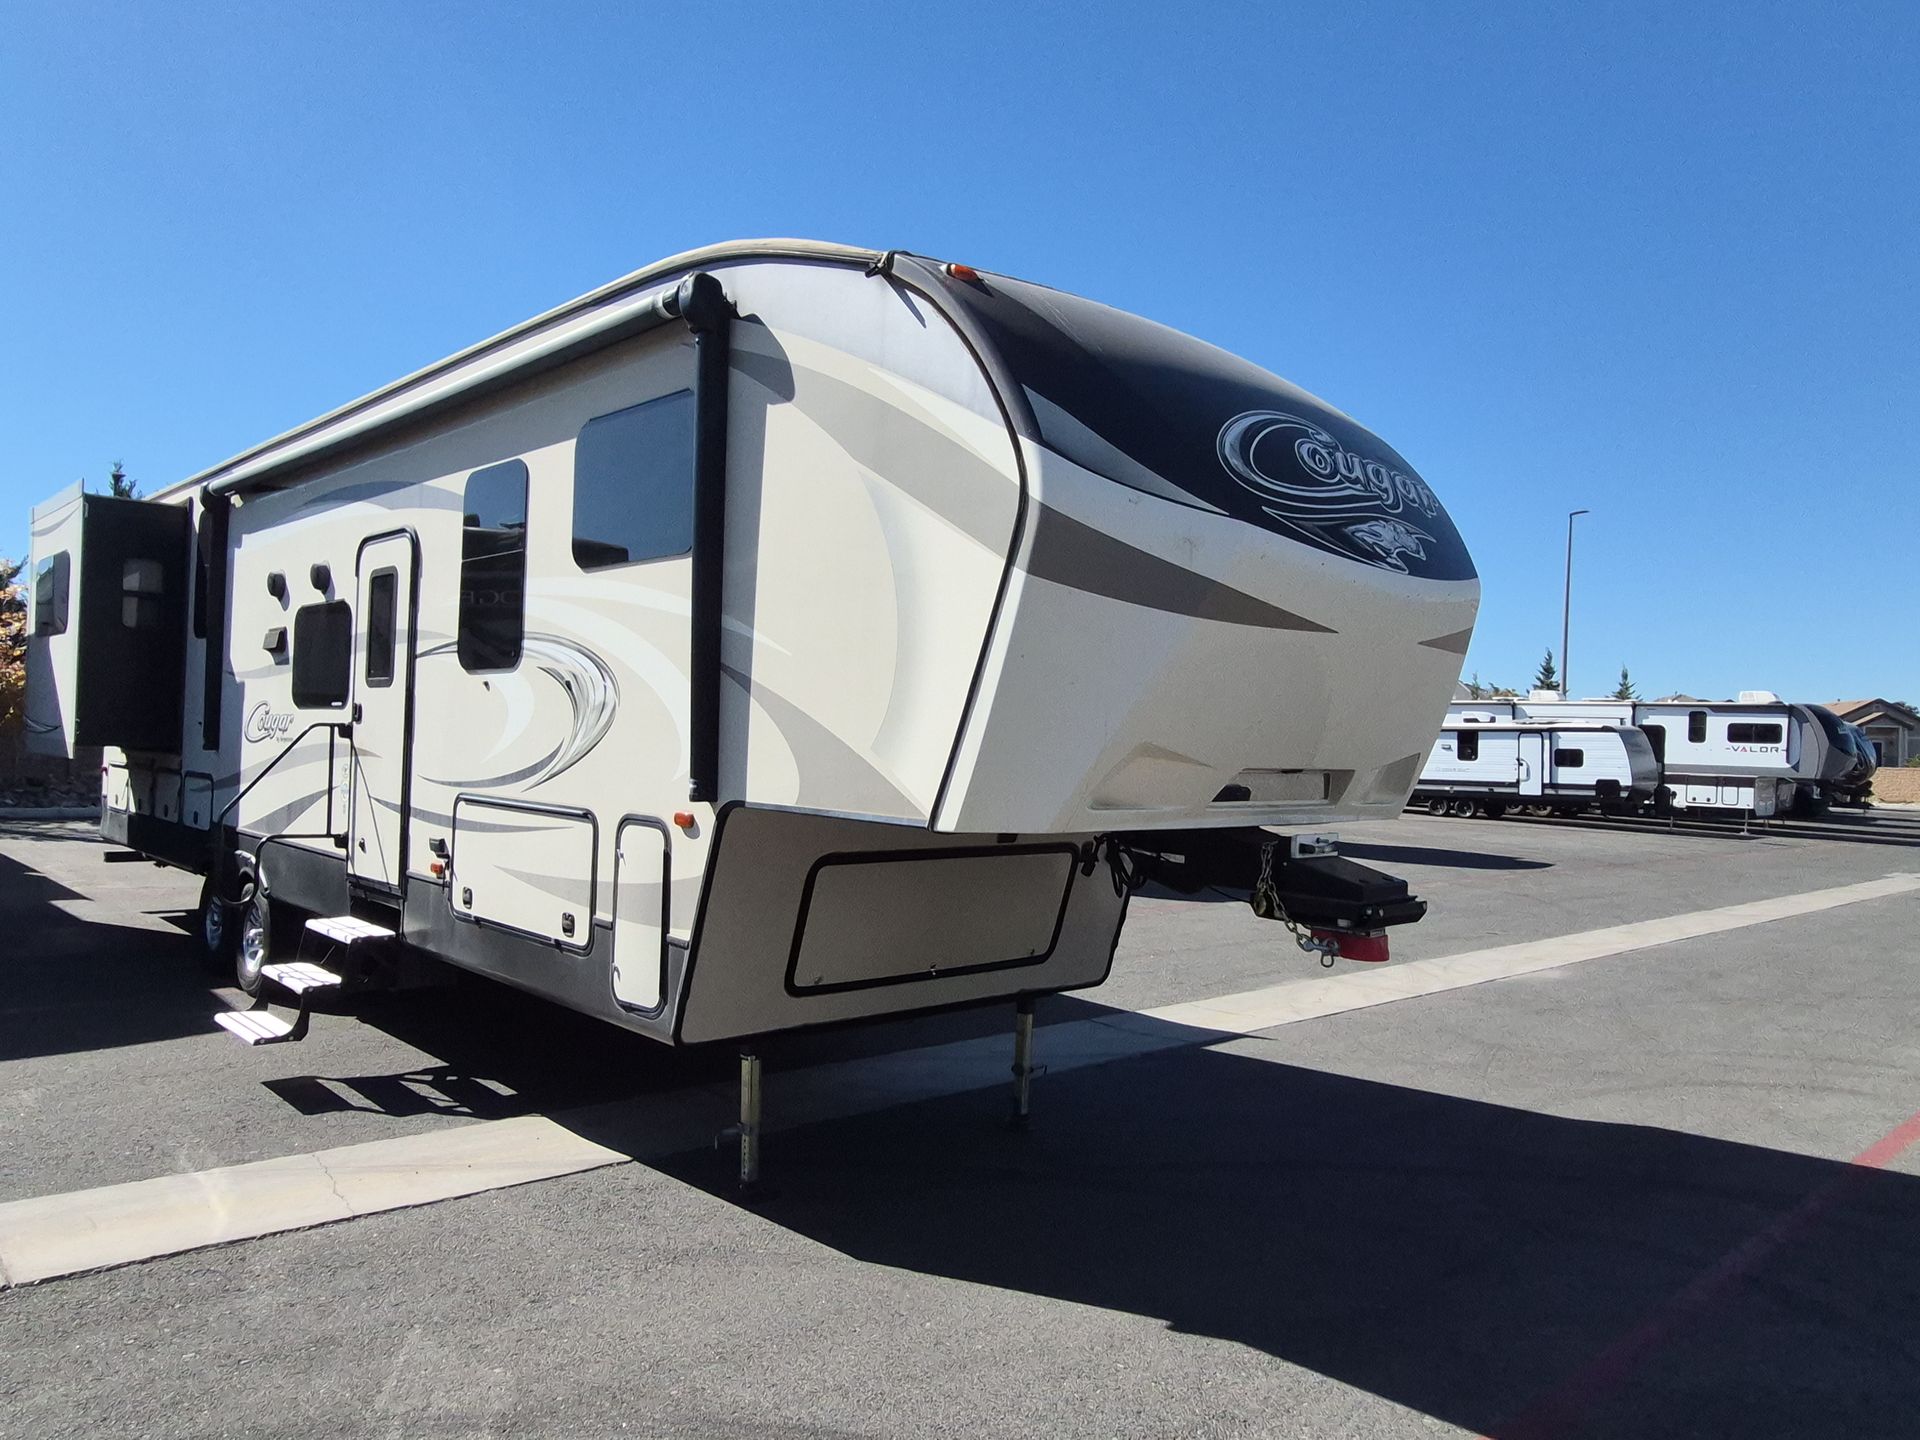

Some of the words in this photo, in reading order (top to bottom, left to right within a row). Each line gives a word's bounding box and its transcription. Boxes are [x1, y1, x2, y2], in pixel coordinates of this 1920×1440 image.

[1216, 410, 1439, 518] Cougar
[244, 701, 294, 743] Cougar
[1731, 745, 1779, 753] VALOR
